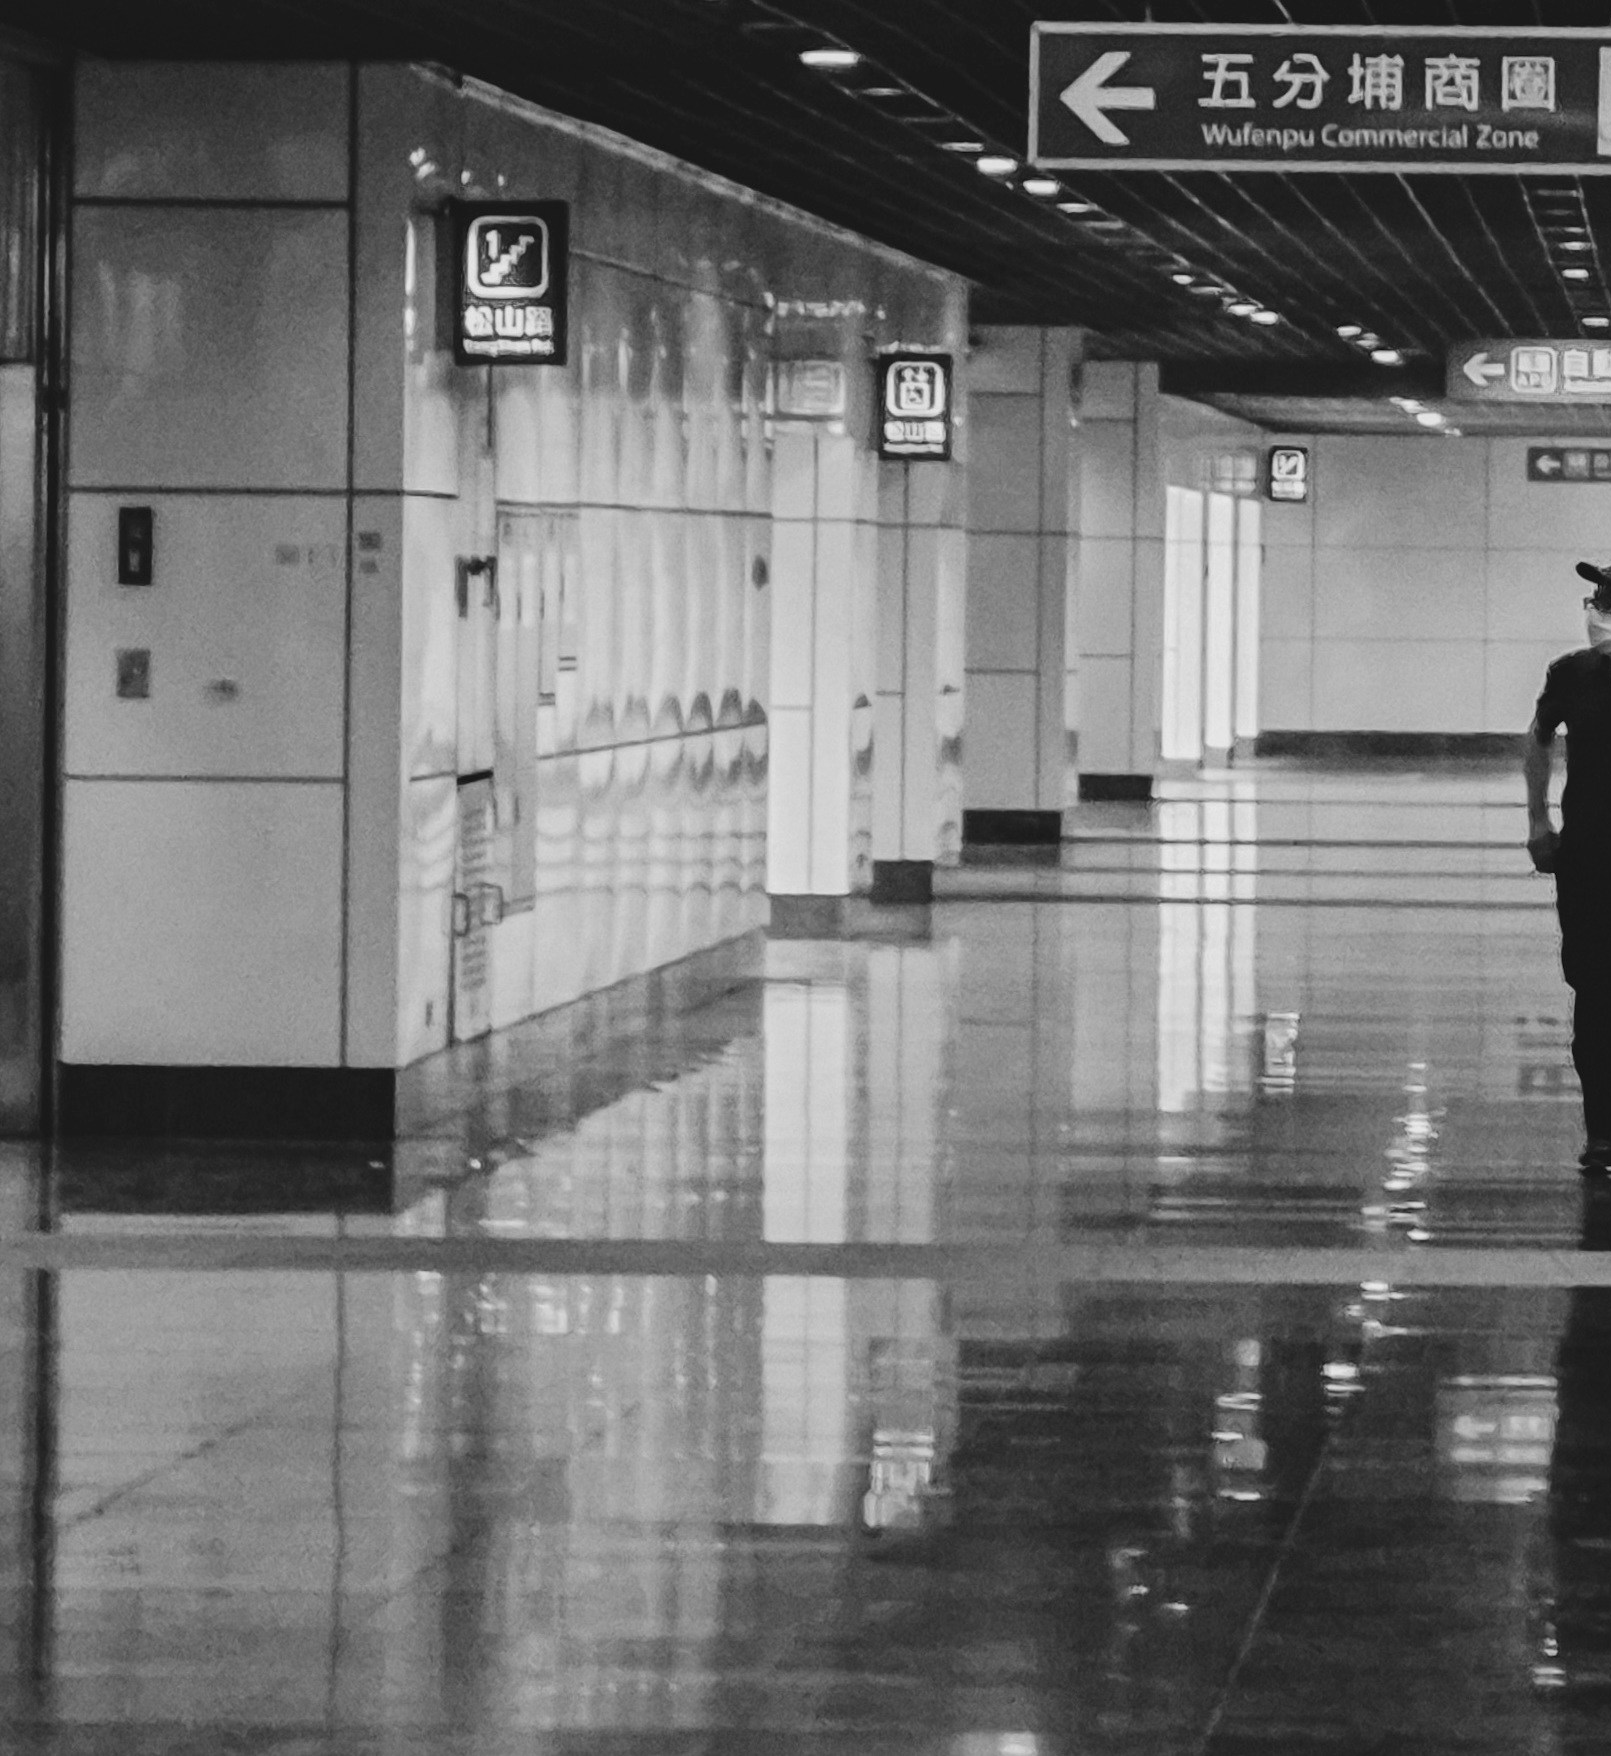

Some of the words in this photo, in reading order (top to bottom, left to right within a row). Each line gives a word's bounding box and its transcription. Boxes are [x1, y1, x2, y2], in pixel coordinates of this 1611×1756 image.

[1197, 52, 1556, 113] 五分埔商圈
[1200, 121, 1314, 153] Wufenpu
[1321, 122, 1468, 149] Commercial
[1475, 123, 1540, 150] Zone
